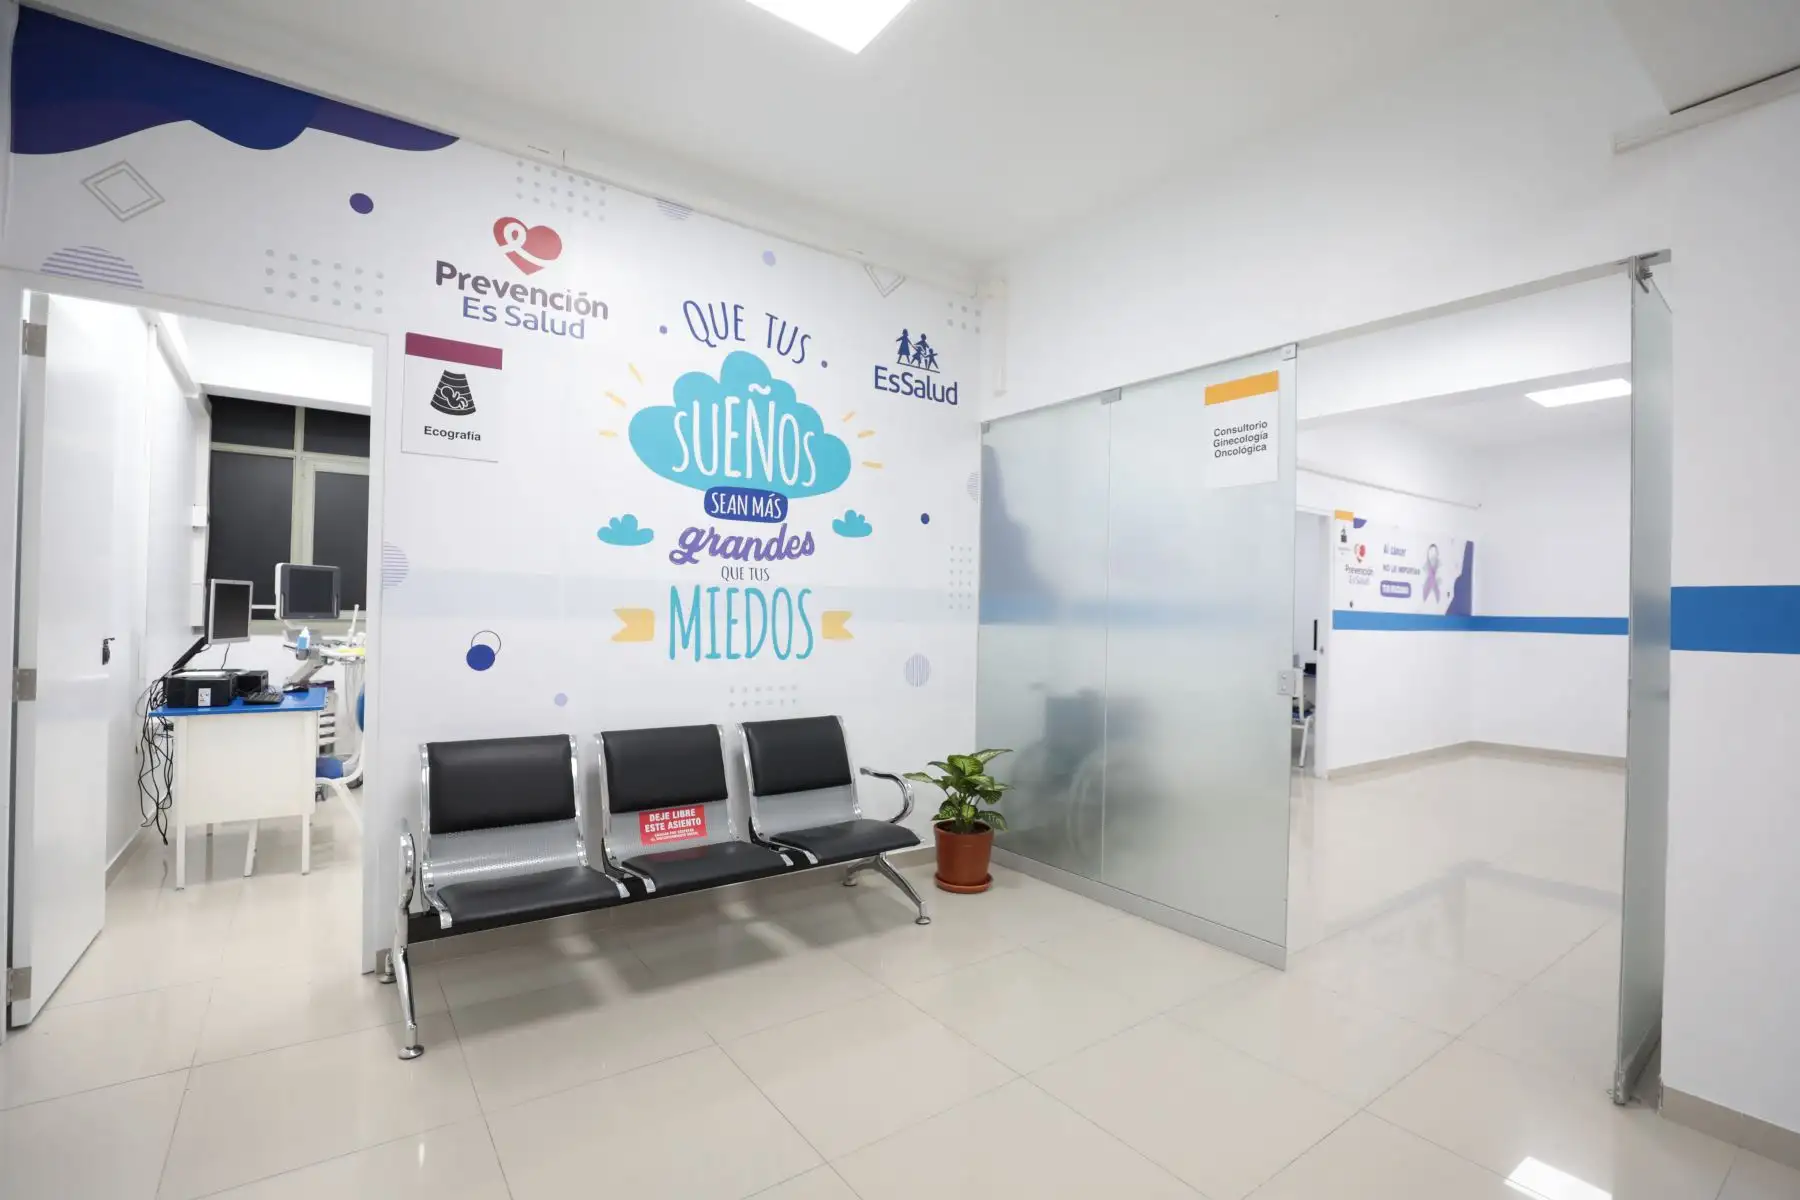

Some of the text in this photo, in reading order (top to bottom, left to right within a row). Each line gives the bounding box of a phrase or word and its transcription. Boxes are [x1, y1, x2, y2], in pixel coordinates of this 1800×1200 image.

[435, 260, 609, 320] Prevención
[462, 296, 586, 340] Es Salud
[682, 299, 812, 365] QUE TUS
[873, 365, 959, 406] EsSalud
[671, 382, 818, 489] SUEÑOS
[1213, 420, 1268, 437] Consultorio
[1214, 443, 1267, 458] Oncológica
[710, 491, 783, 519] SEAN MÁS
[668, 522, 816, 566] grandes
[720, 565, 770, 583] QUE TUS
[668, 584, 815, 663] MIEDOS
[645, 822, 666, 833] ESTE
[667, 817, 702, 830] ASIENTO
[649, 808, 696, 822] DEJE LIBRE
